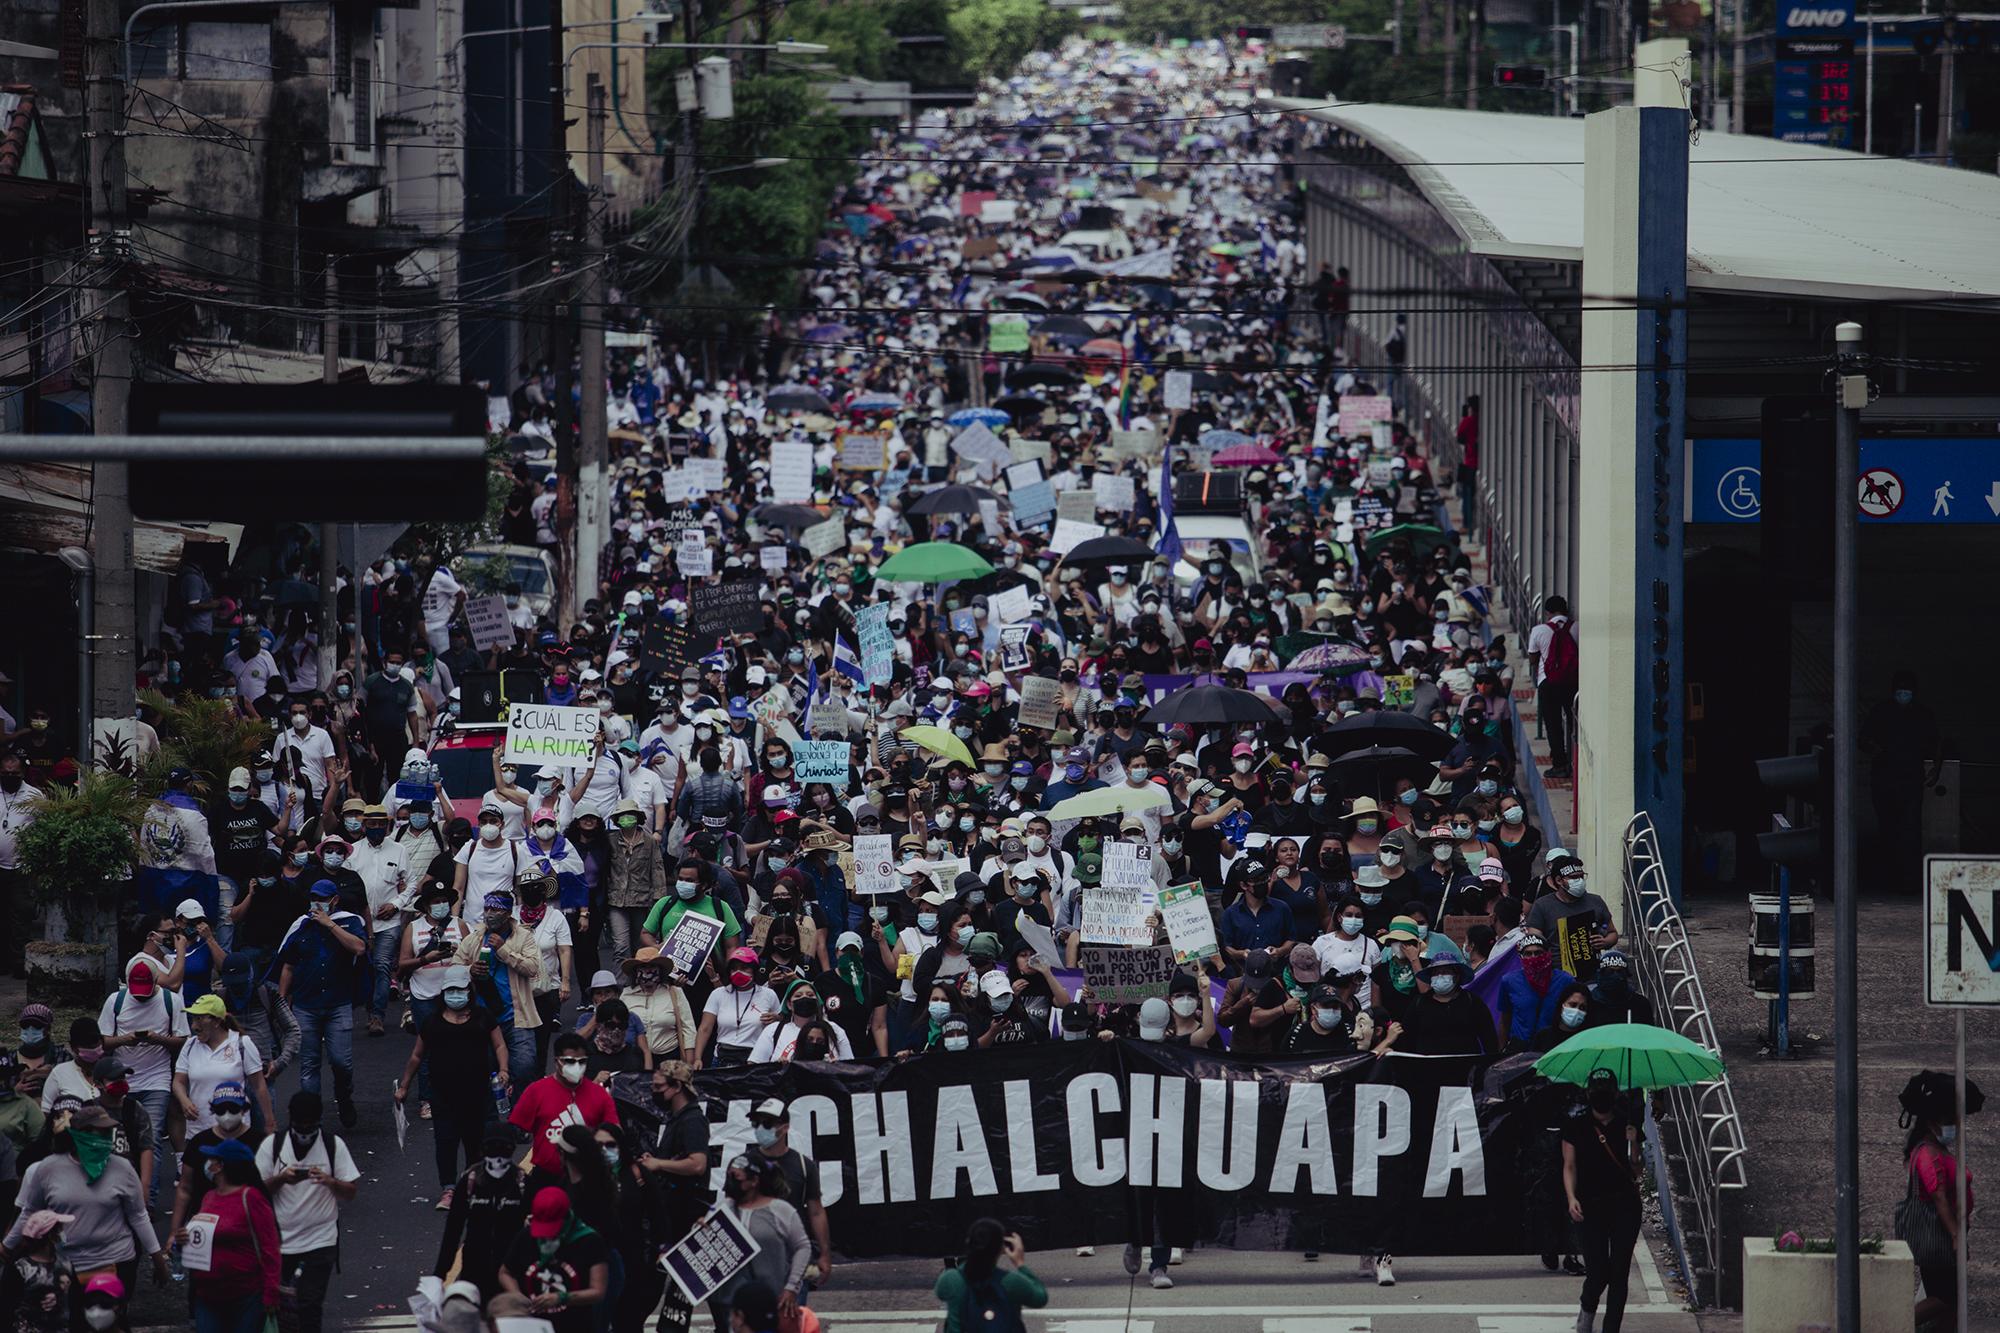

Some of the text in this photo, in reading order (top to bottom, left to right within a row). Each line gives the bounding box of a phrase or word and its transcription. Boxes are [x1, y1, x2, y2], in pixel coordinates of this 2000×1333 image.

[1787, 8, 1847, 28] UNO
[512, 708, 596, 733] ¿CUÁL ES
[514, 735, 596, 762] LA RUTA?
[226, 817, 258, 829] ALWAYS
[1103, 843, 1124, 857] DEJA
[1104, 856, 1151, 874] Y LUCHA POR
[1114, 871, 1149, 887] SALVADOR
[1082, 924, 1095, 935] NO
[1096, 926, 1104, 935] A
[1107, 926, 1117, 936] LA
[673, 932, 708, 951] ESTAFA PARA
[674, 940, 683, 949] EL
[1084, 949, 1161, 962] YO MARCHO
[1112, 962, 1136, 974] POR
[1140, 960, 1160, 972] UN
[1088, 976, 1115, 987] QUE
[655, 1070, 1487, 1206] #CHALCHUAPA
[716, 1228, 744, 1262] QUEREMOS
